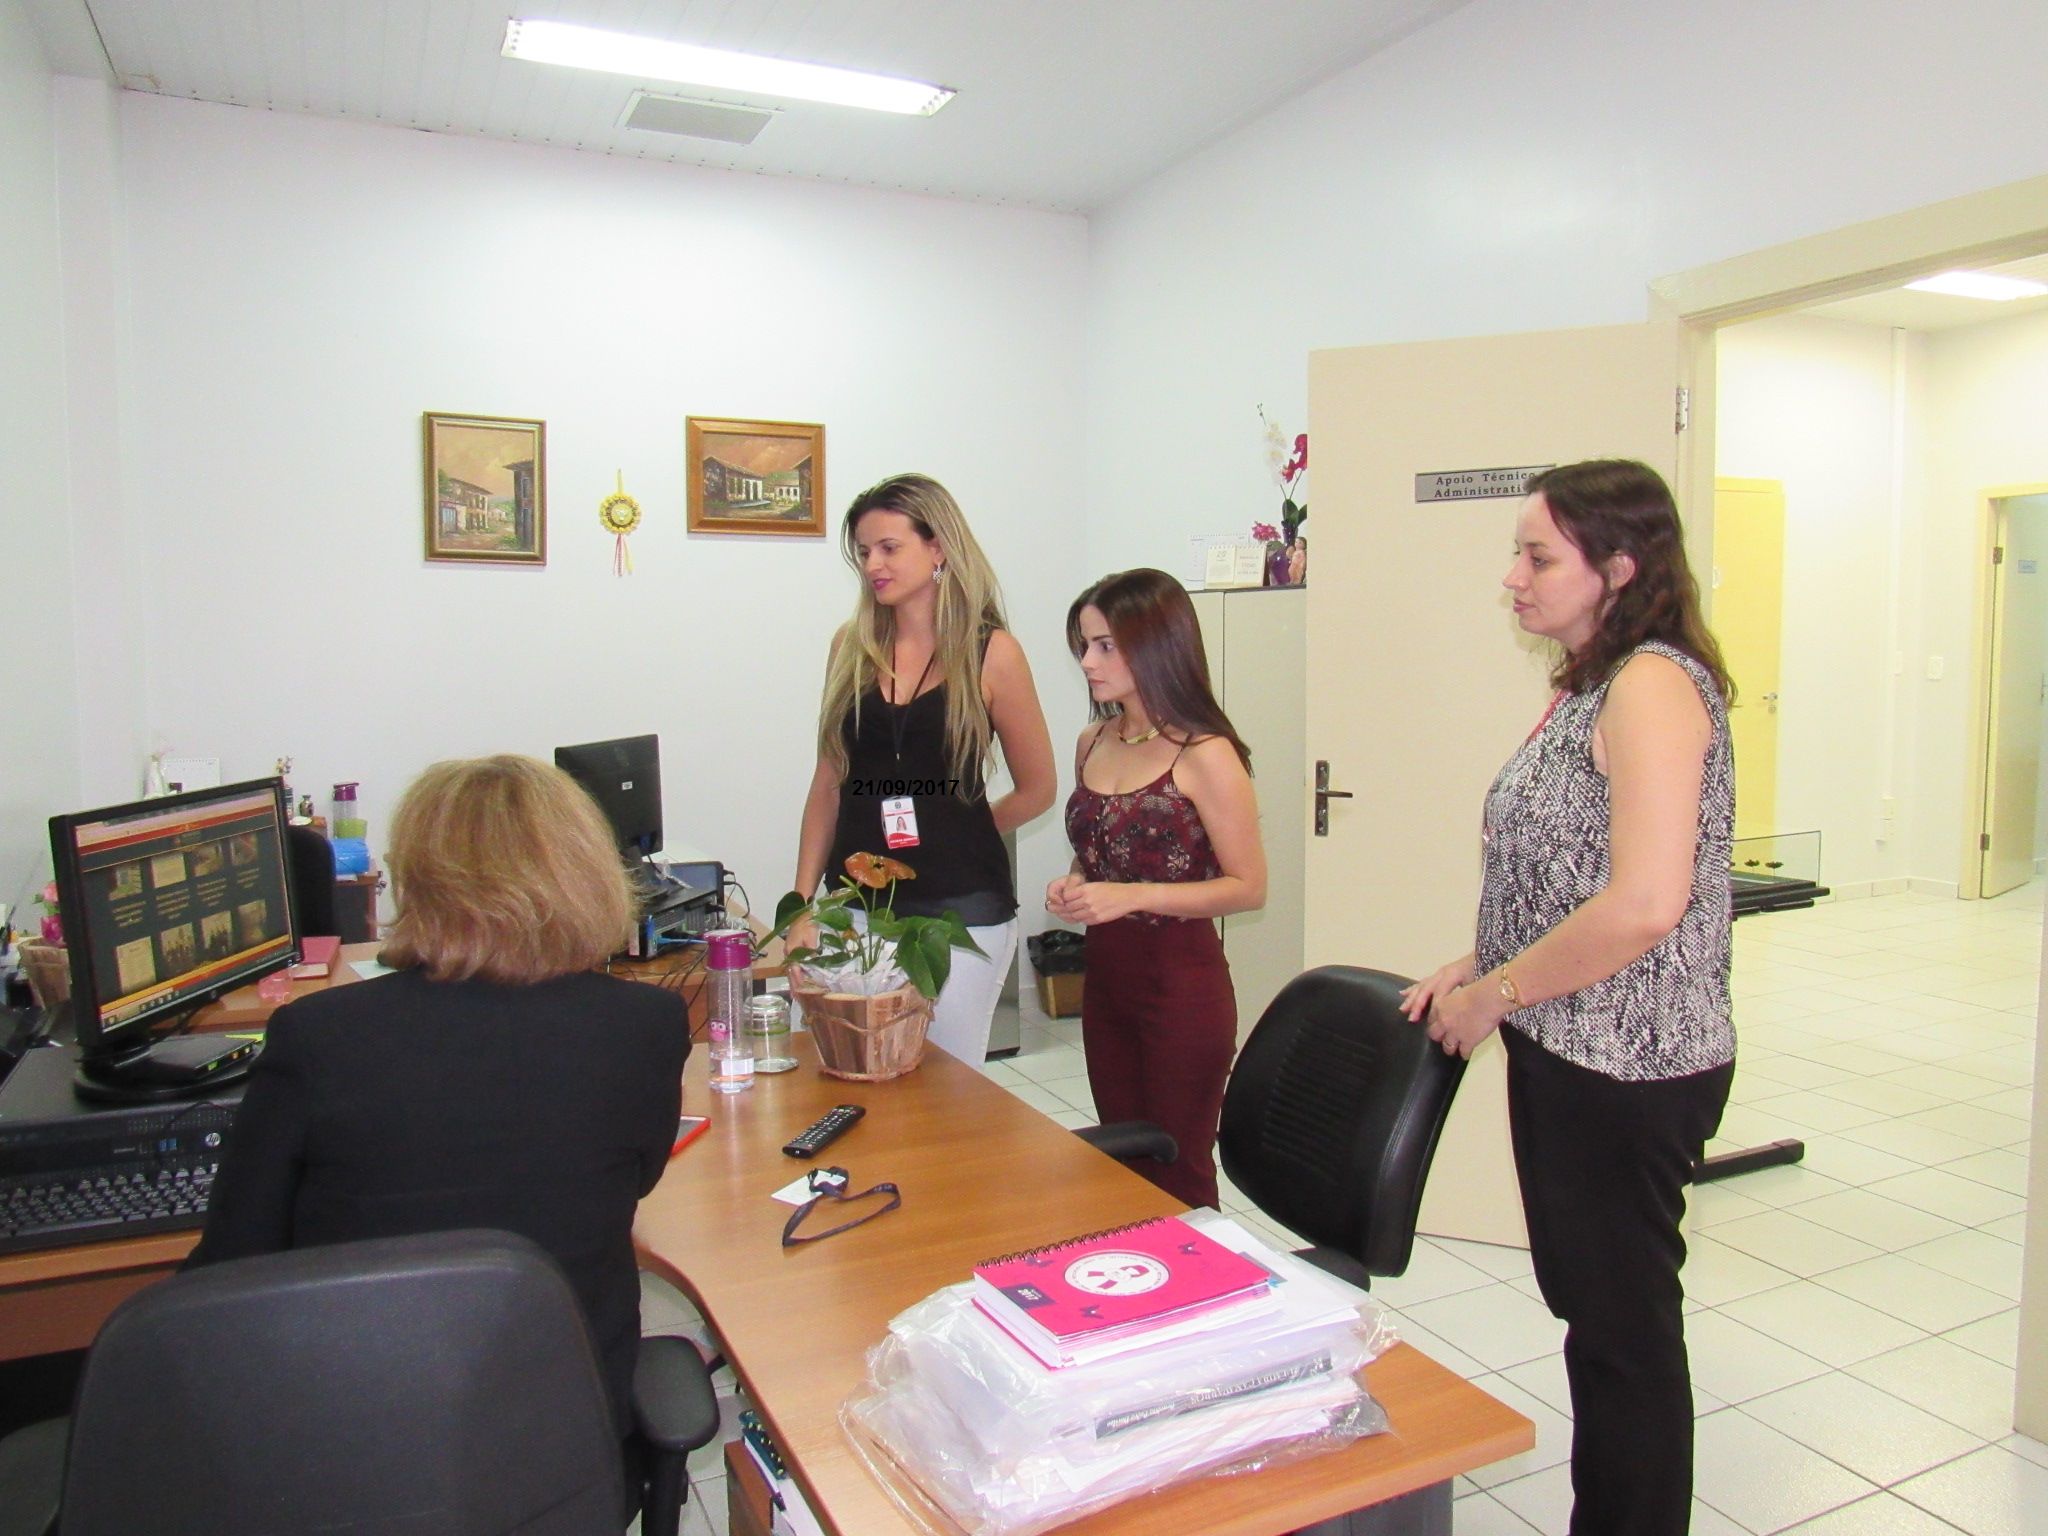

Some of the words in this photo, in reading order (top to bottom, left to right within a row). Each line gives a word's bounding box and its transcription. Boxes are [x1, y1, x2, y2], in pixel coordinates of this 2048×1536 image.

[1436, 475, 1474, 486] Apoio
[1482, 472, 1536, 482] Técnico
[1434, 484, 1523, 498] Administrati
